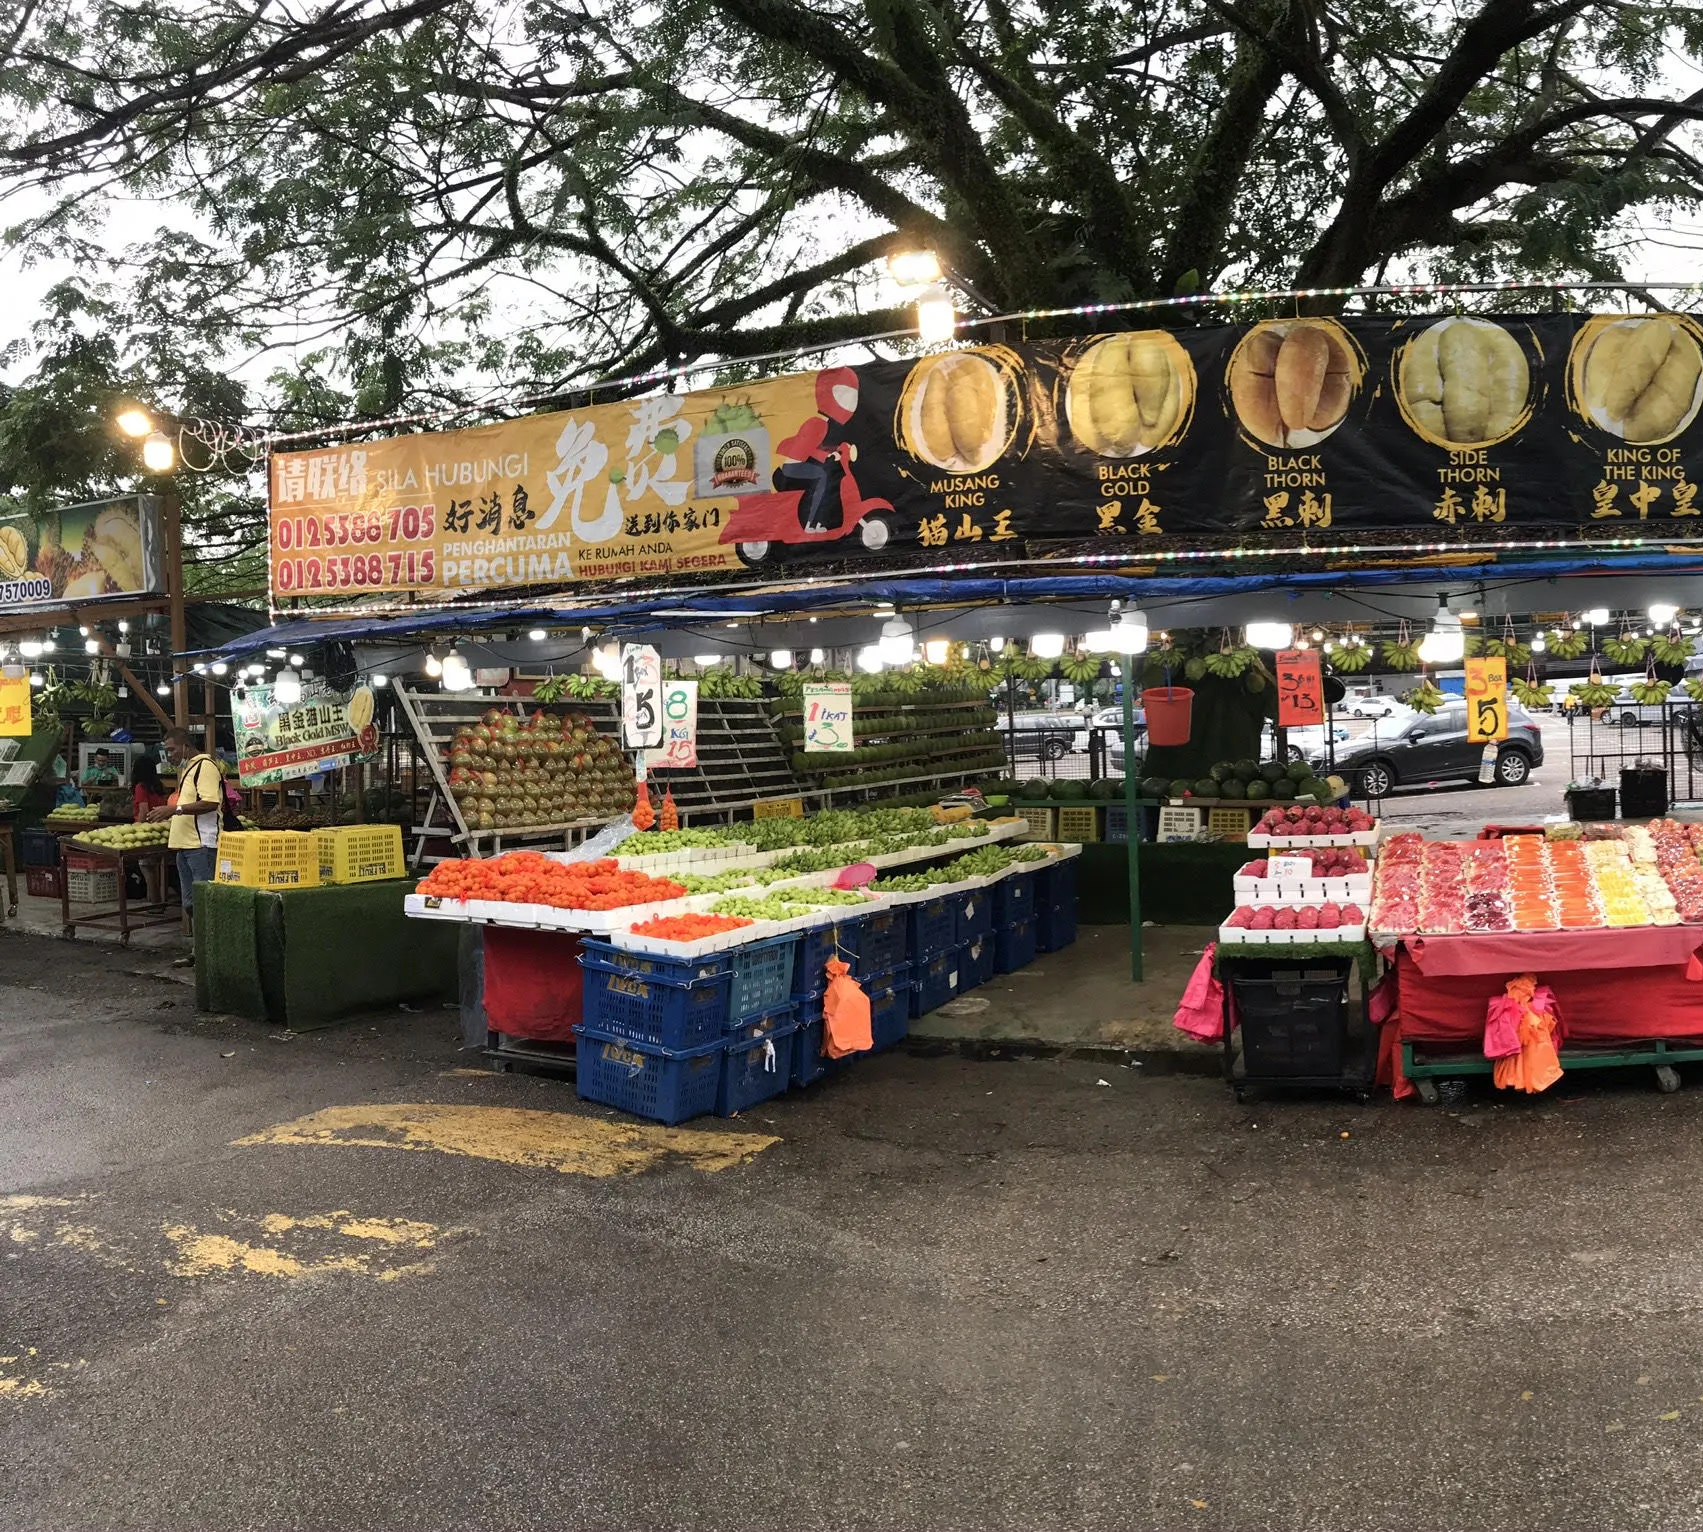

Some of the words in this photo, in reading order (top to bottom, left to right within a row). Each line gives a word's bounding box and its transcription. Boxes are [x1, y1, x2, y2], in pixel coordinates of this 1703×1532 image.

[534, 394, 696, 543] 免费
[1267, 454, 1323, 471] BLACK
[1449, 450, 1489, 466] SIDE
[1607, 448, 1651, 463] KING
[1656, 448, 1682, 463] OF
[276, 450, 369, 503] 请联络
[376, 467, 419, 492] SILA
[425, 453, 529, 488] HUBUNGI
[930, 474, 1000, 494] MUSANG
[1098, 463, 1151, 481] BLACK
[1264, 472, 1326, 489] THORN
[1437, 467, 1500, 484] THORN
[1603, 465, 1636, 480] THE
[1641, 465, 1686, 480] KING
[945, 492, 985, 509] KING
[1100, 480, 1150, 497] GOLD
[1590, 479, 1701, 520] 皇中皇
[442, 483, 536, 537] 好消息
[1095, 497, 1164, 536] 黑金
[1260, 489, 1333, 530] 黑刺
[1432, 484, 1507, 525] 赤刺
[624, 506, 720, 538] 送到你家门
[917, 508, 1021, 548] 猫山王
[442, 531, 572, 558] PENGHANTARAN
[578, 548, 593, 562] KE
[595, 544, 636, 560] RUMAH
[637, 542, 674, 557] ANDA
[442, 553, 575, 586] PERCUMA
[579, 561, 636, 578] HUBUNGI
[639, 557, 673, 573] KAMI
[676, 554, 727, 570] SEGERA
[1280, 672, 1299, 692] 3
[1467, 667, 1488, 696] 3
[278, 703, 344, 733] 黑金猫山王
[636, 688, 656, 730] 5
[667, 690, 688, 720] 8
[808, 702, 819, 721] 1
[1478, 697, 1498, 737] 5
[275, 732, 302, 748] Black
[302, 728, 324, 742] Gold
[323, 721, 350, 737] MSW
[667, 741, 693, 760] 15
